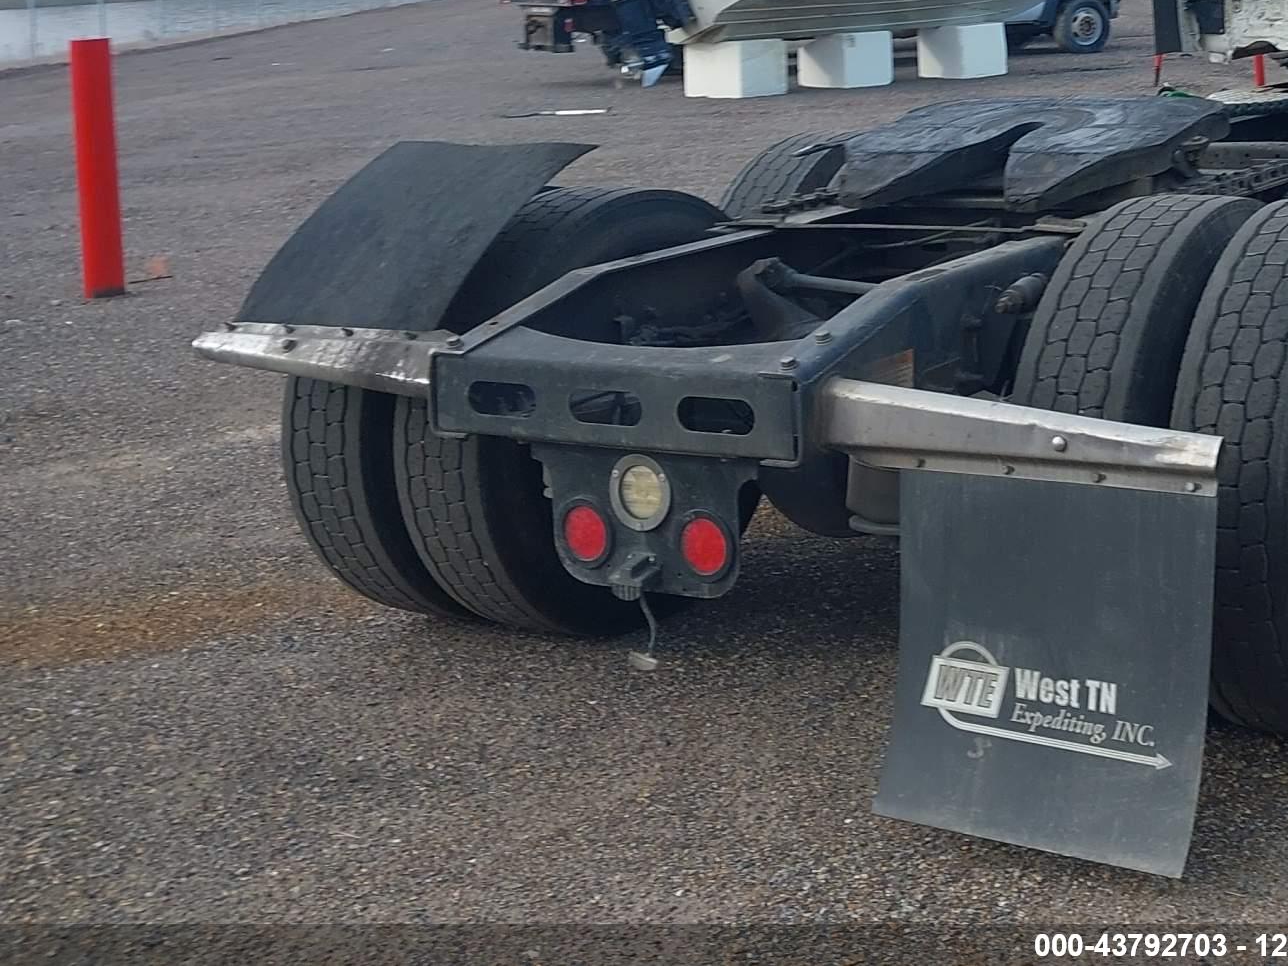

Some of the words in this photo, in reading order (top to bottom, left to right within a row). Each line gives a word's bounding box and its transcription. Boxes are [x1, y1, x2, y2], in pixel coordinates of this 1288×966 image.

[933, 664, 1000, 709] WTE
[1014, 667, 1081, 709] West
[1085, 679, 1118, 715] TN
[1111, 720, 1156, 747] INC.
